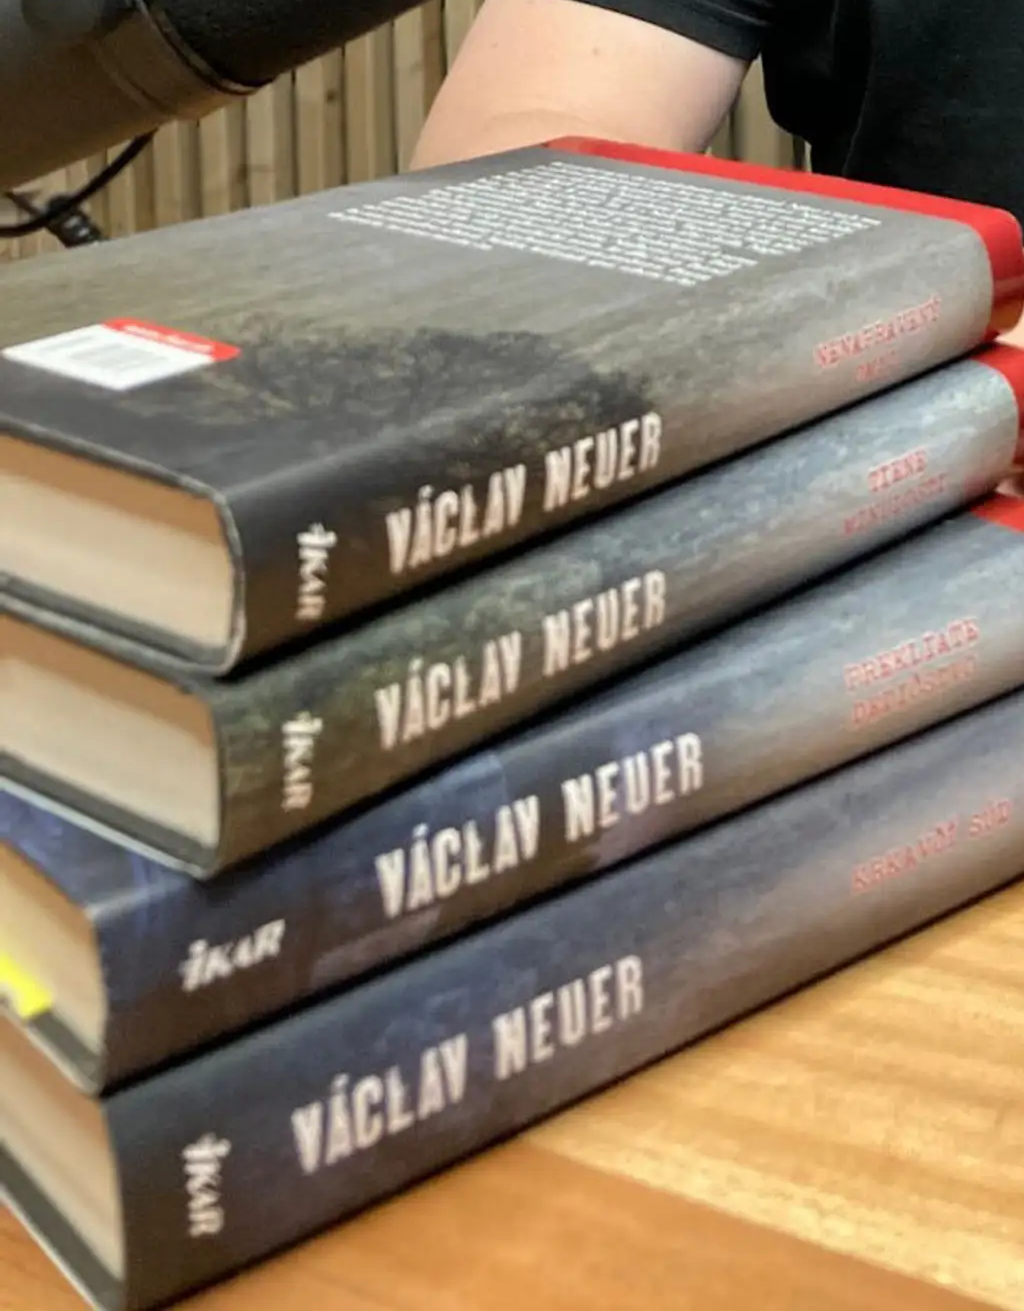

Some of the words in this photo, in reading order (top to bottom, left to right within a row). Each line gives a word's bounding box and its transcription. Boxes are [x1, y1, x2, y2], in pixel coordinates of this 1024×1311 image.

[385, 463, 527, 574] VÁCLAV
[543, 411, 662, 511] NEUER
[374, 630, 522, 750] VÁCLAV
[542, 569, 667, 677] NEUER
[375, 794, 541, 919] VÁCLAV
[561, 732, 704, 842] NEUER
[291, 1034, 468, 1174] VÁCLAV
[493, 954, 645, 1081] NEUER
